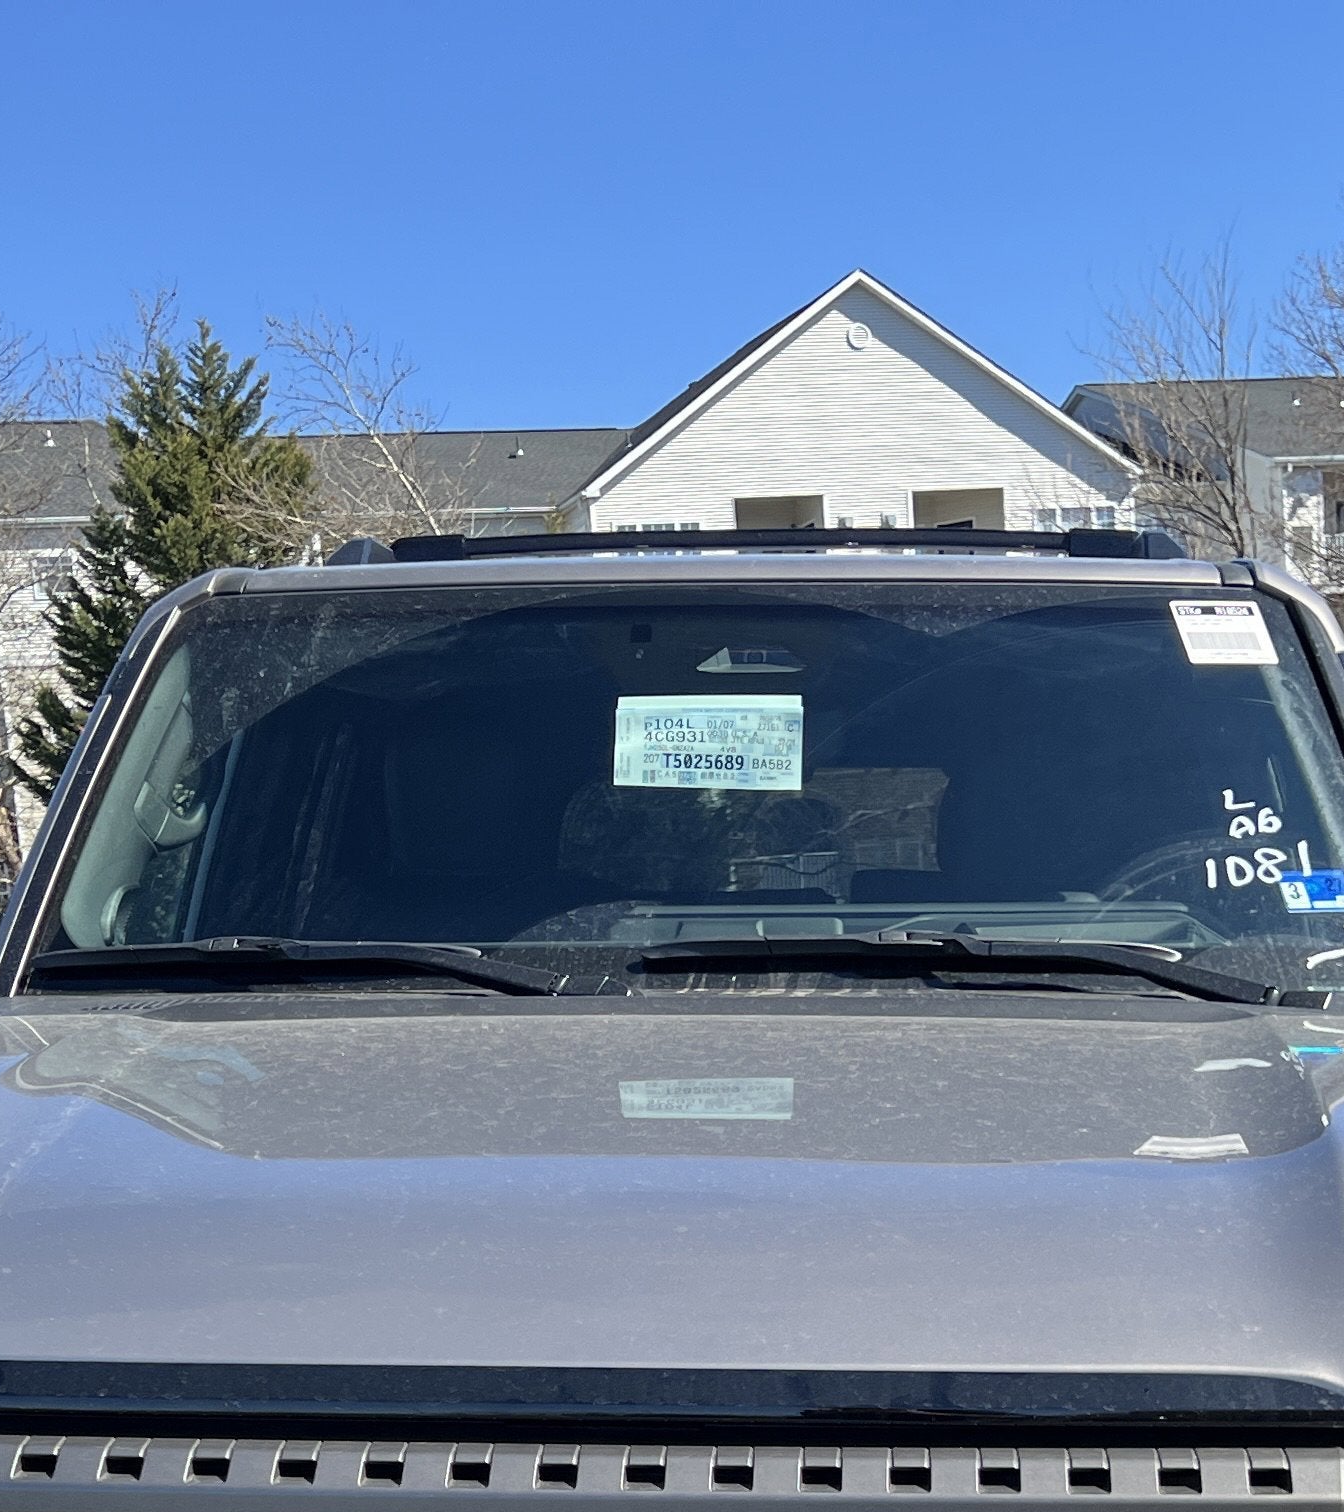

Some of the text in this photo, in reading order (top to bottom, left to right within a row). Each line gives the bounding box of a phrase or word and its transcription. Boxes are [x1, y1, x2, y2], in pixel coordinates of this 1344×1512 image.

[644, 730, 706, 743] 4CG931
[662, 753, 744, 770] T5025689
[1222, 788, 1256, 810] L
[1205, 840, 1312, 889] 1081
[1288, 883, 1301, 899] 3
